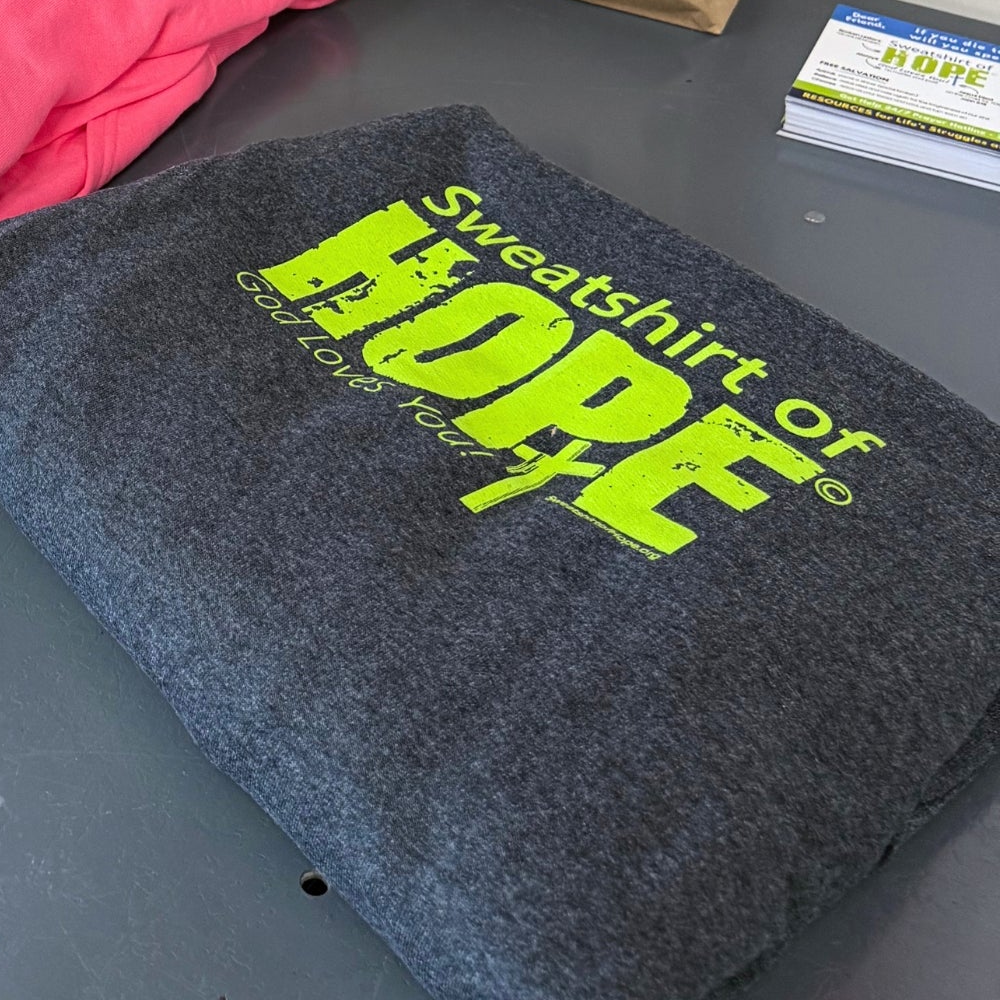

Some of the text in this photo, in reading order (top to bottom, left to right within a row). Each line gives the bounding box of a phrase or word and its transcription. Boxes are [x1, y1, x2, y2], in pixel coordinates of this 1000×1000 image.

[802, 91, 872, 116] RESOURCES
[874, 111, 893, 121] for
[881, 47, 988, 87] HOPE
[890, 40, 970, 67] Sweatshirt
[236, 271, 495, 457] God Loves You!
[258, 199, 826, 555] HOPE
[422, 185, 887, 458] Sweatshirt of
